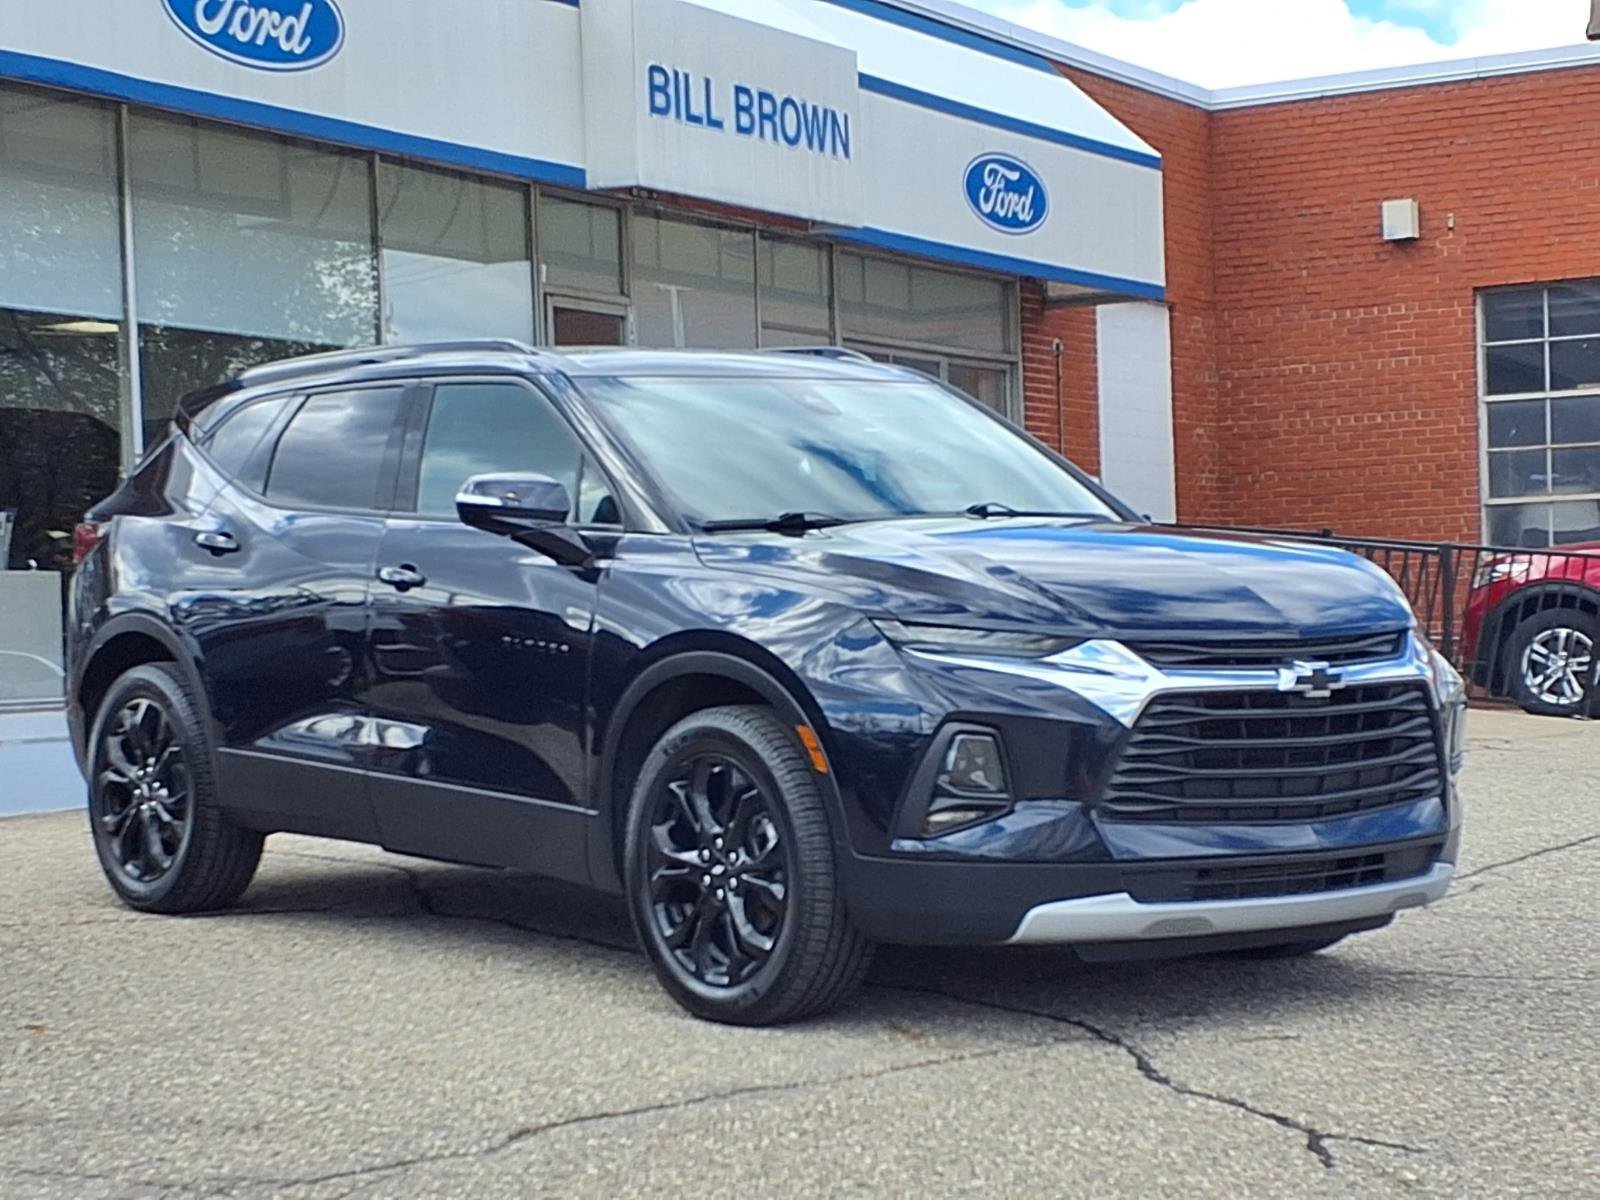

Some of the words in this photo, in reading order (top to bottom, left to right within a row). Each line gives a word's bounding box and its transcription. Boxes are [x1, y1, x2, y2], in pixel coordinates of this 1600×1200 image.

[648, 64, 724, 130] BILL
[734, 84, 850, 159] BROWN
[979, 163, 1034, 222] Ford
